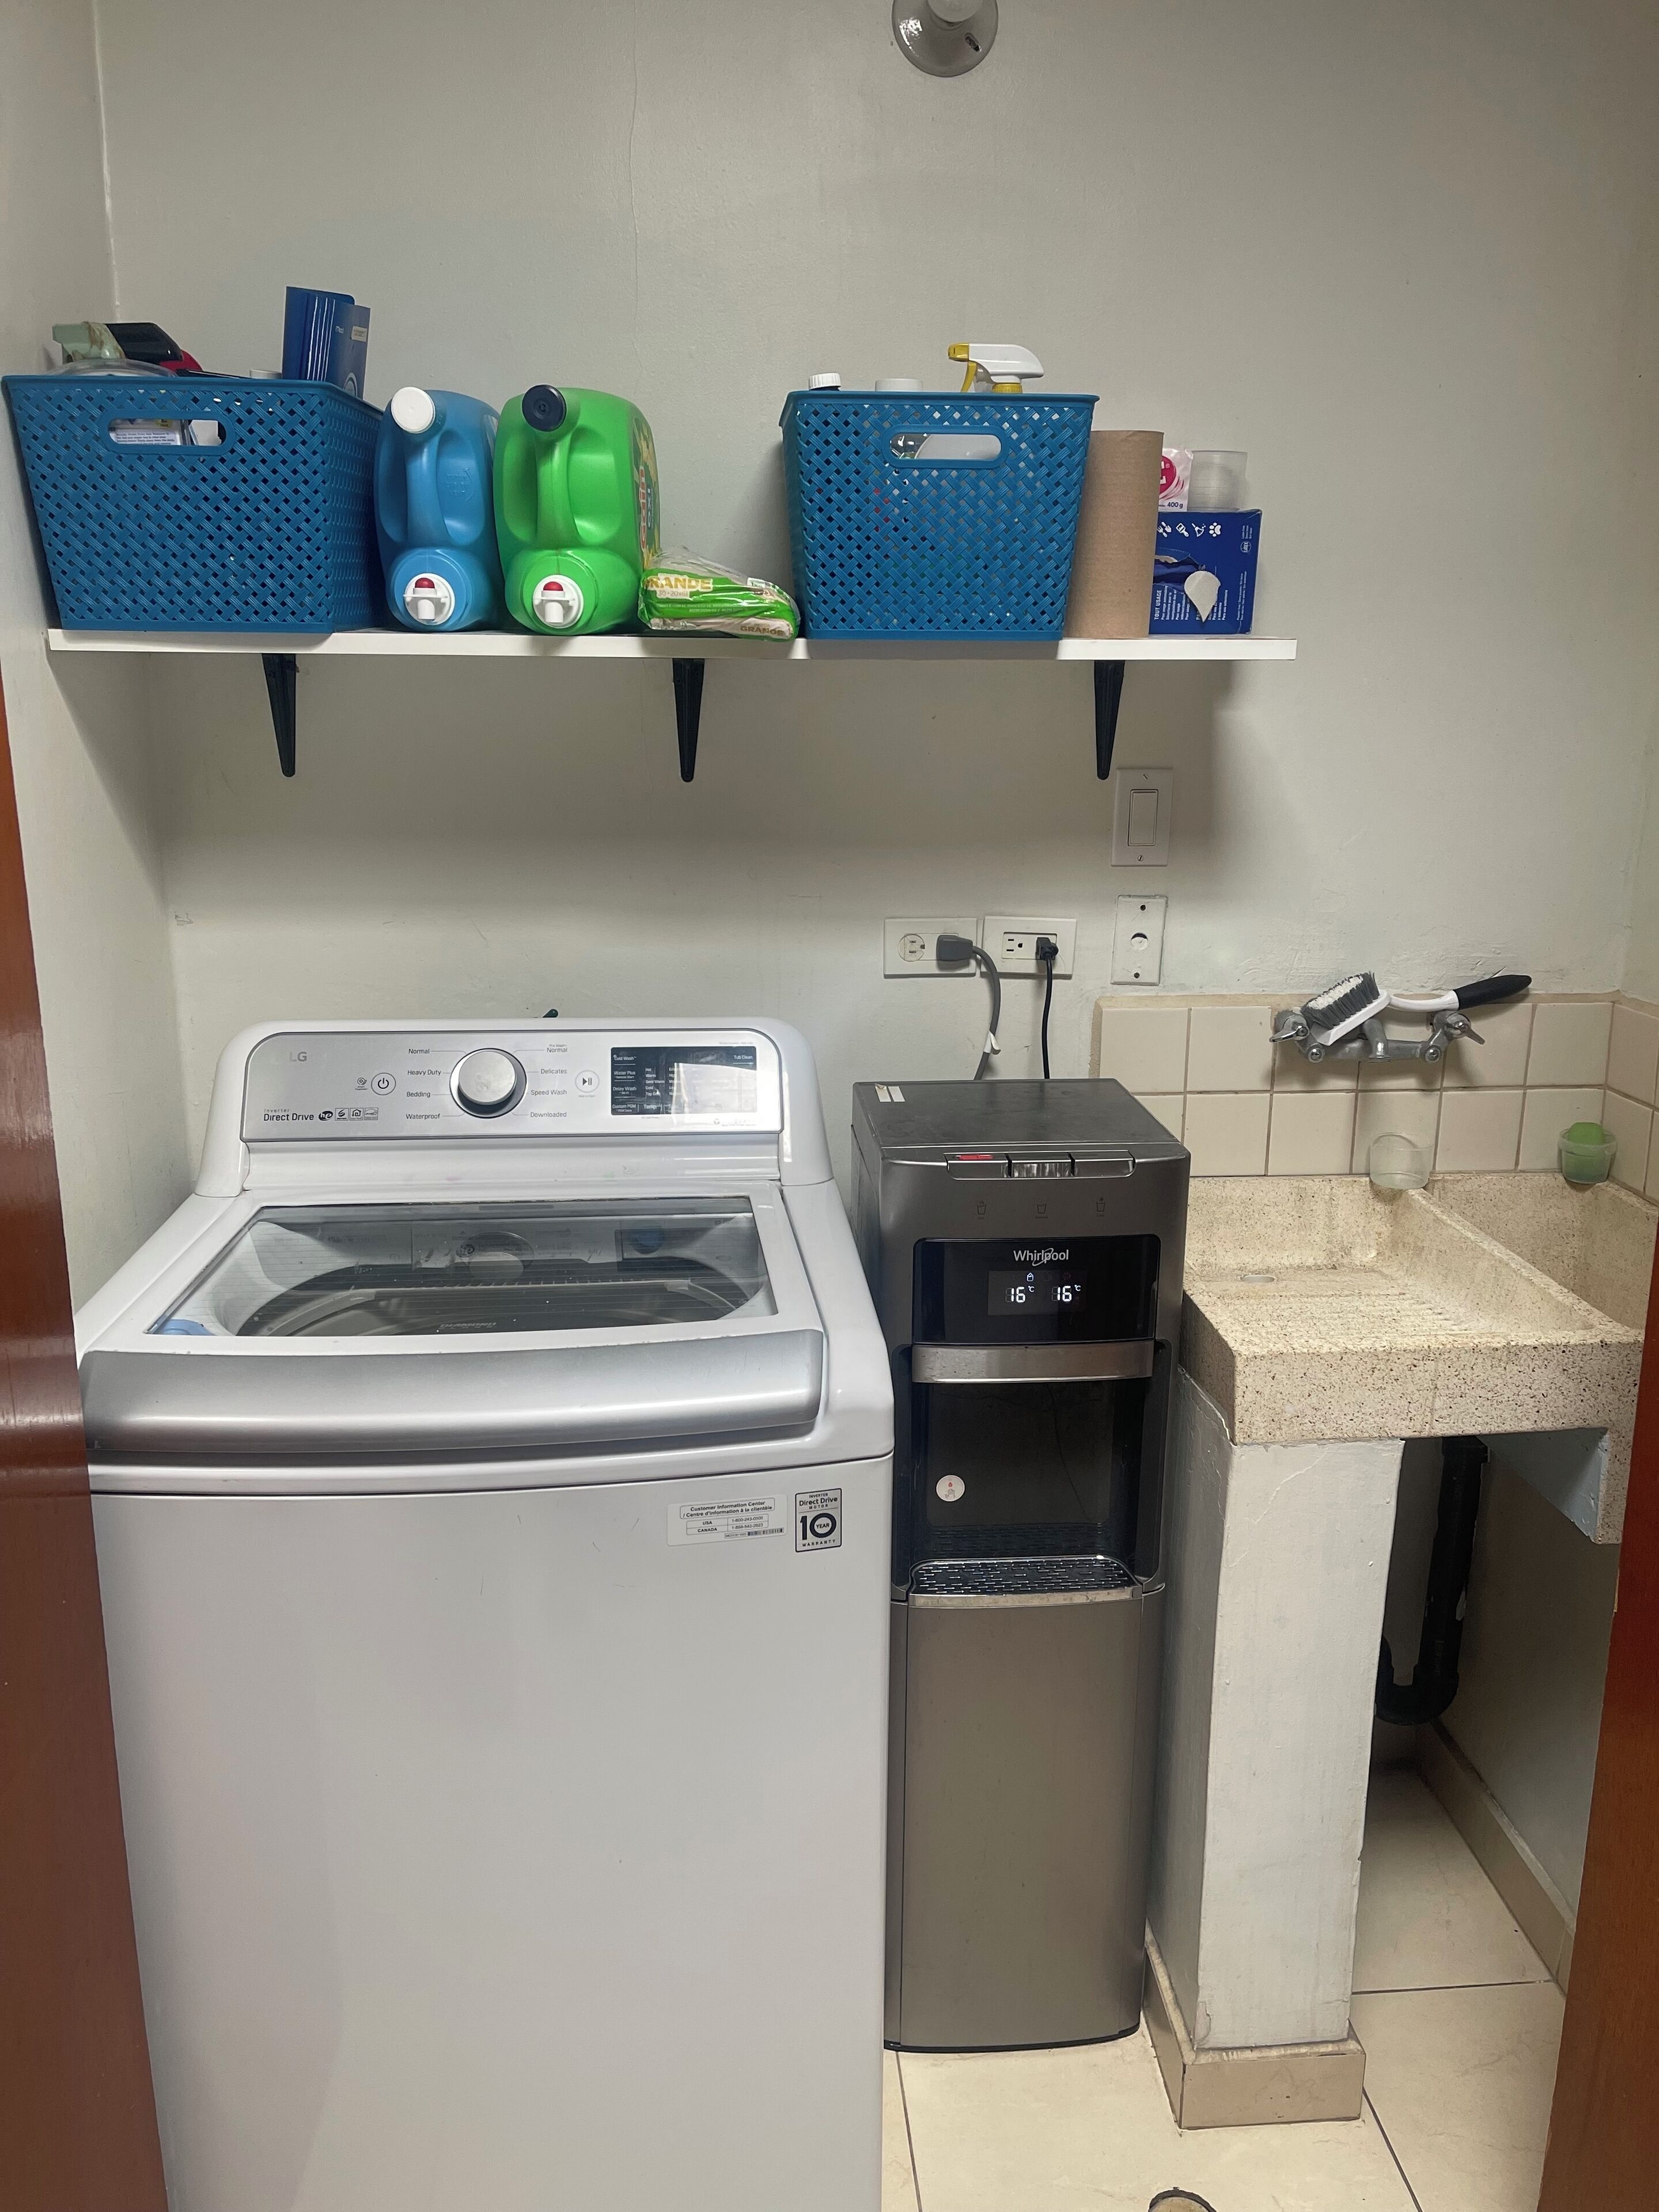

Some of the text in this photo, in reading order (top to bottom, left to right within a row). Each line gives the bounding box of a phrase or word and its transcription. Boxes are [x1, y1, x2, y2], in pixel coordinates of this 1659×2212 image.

[289, 1051, 308, 1062] LG
[291, 1113, 314, 1121] Drive
[1013, 1248, 1069, 1266] Whirlpool
[800, 1513, 837, 1540] 10
[802, 1539, 836, 1547] WARRANTY
